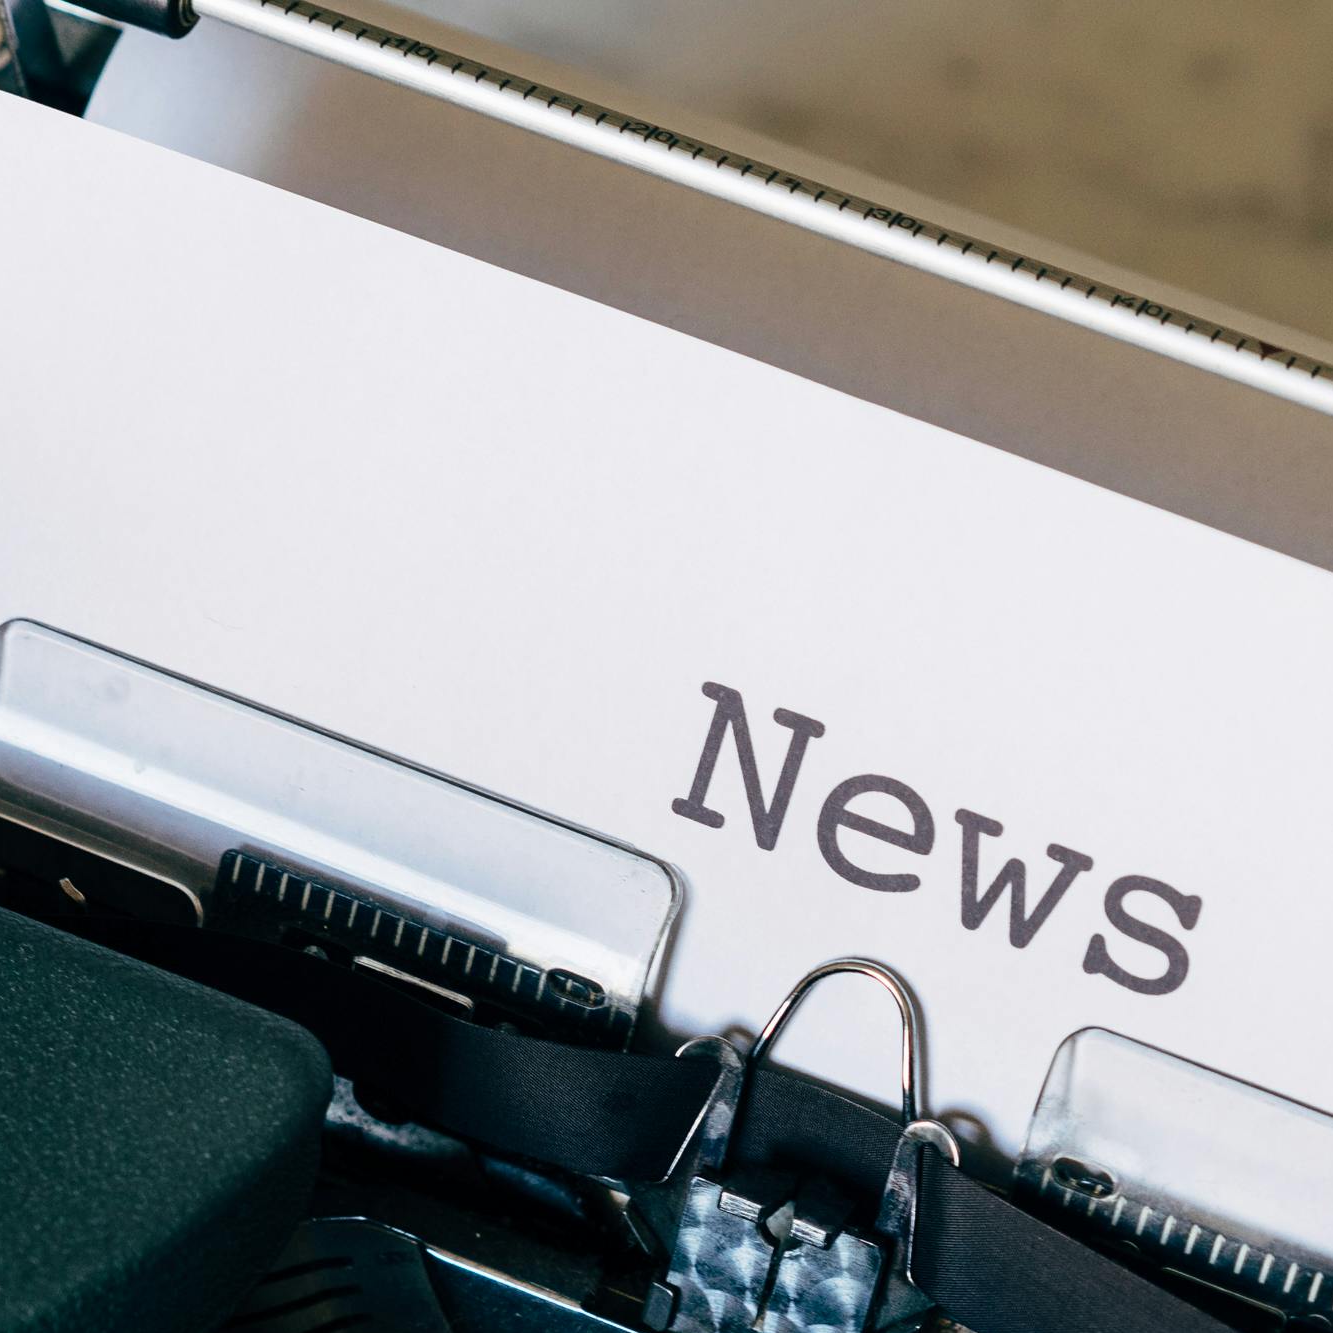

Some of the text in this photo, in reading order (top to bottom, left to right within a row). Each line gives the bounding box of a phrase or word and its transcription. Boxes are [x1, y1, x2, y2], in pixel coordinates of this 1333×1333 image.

[628, 122, 675, 143] 20
[871, 208, 917, 229] 30
[1119, 296, 1164, 317] 40
[671, 681, 1203, 996] News
